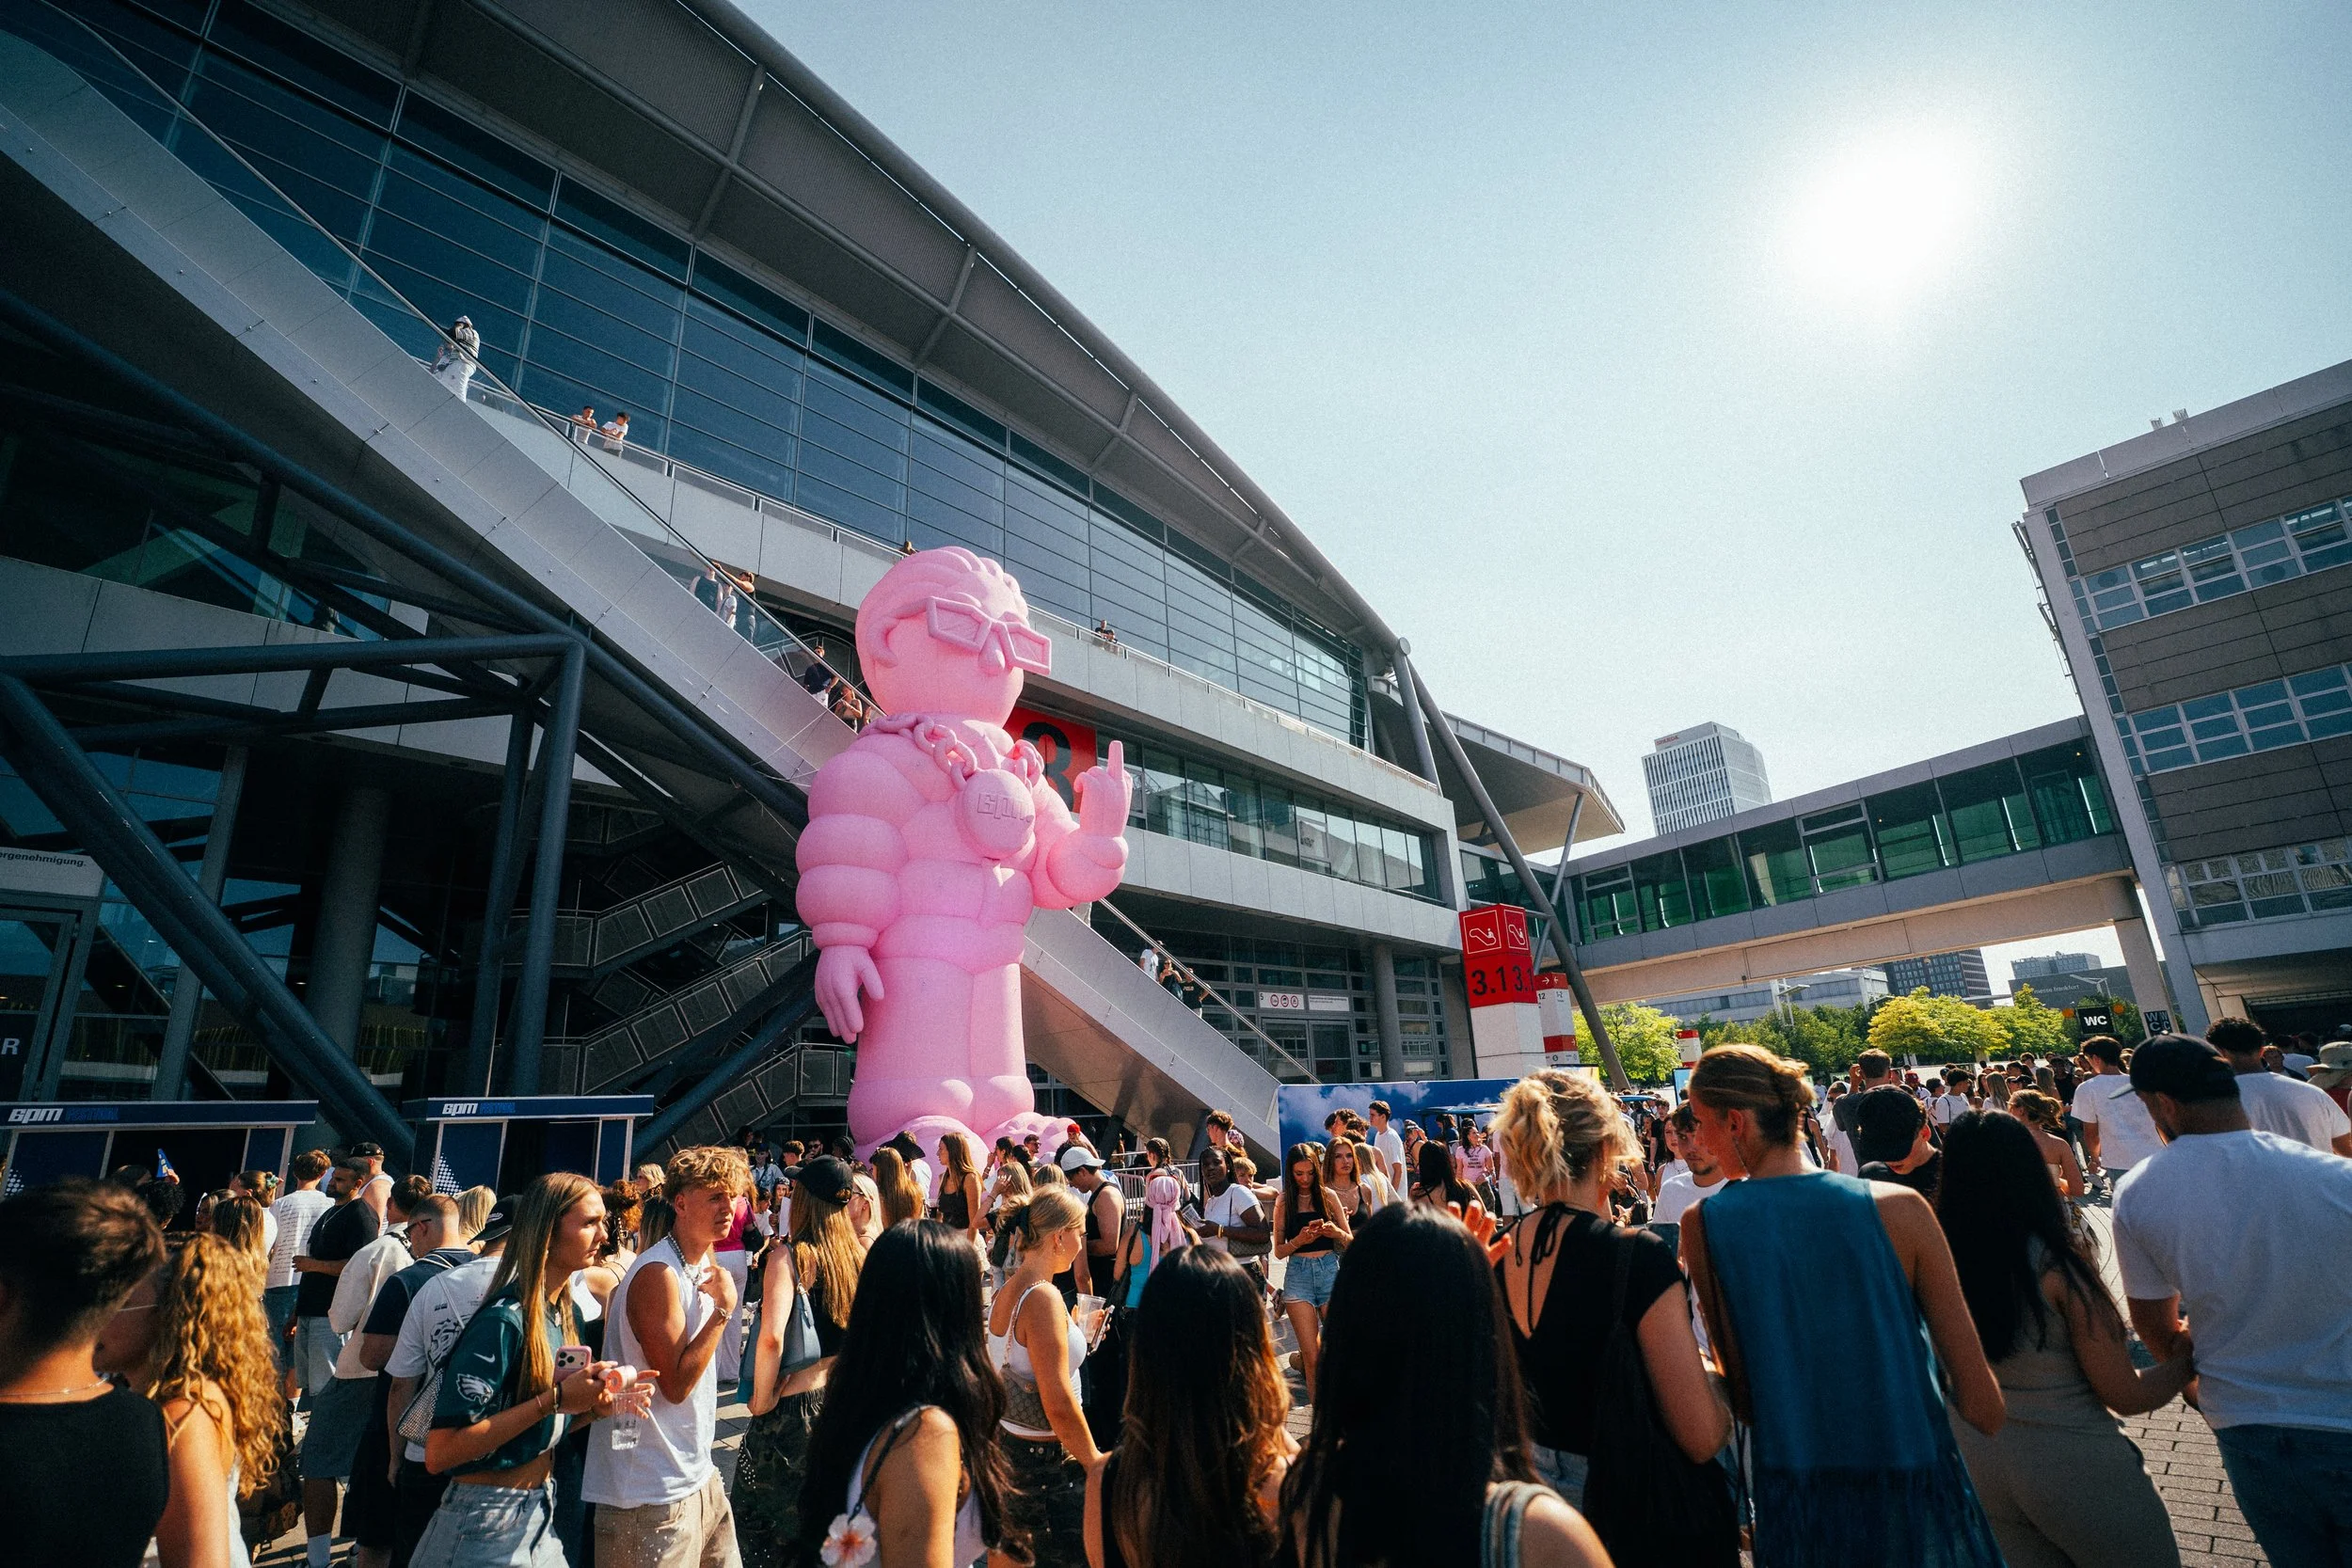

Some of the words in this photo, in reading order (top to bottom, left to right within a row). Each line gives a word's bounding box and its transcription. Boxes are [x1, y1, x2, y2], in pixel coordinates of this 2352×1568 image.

[1471, 966, 1507, 996] 3.1
[2084, 1015, 2107, 1026] WC
[8, 1108, 63, 1124] 6pm
[442, 1102, 478, 1116] 6pm
